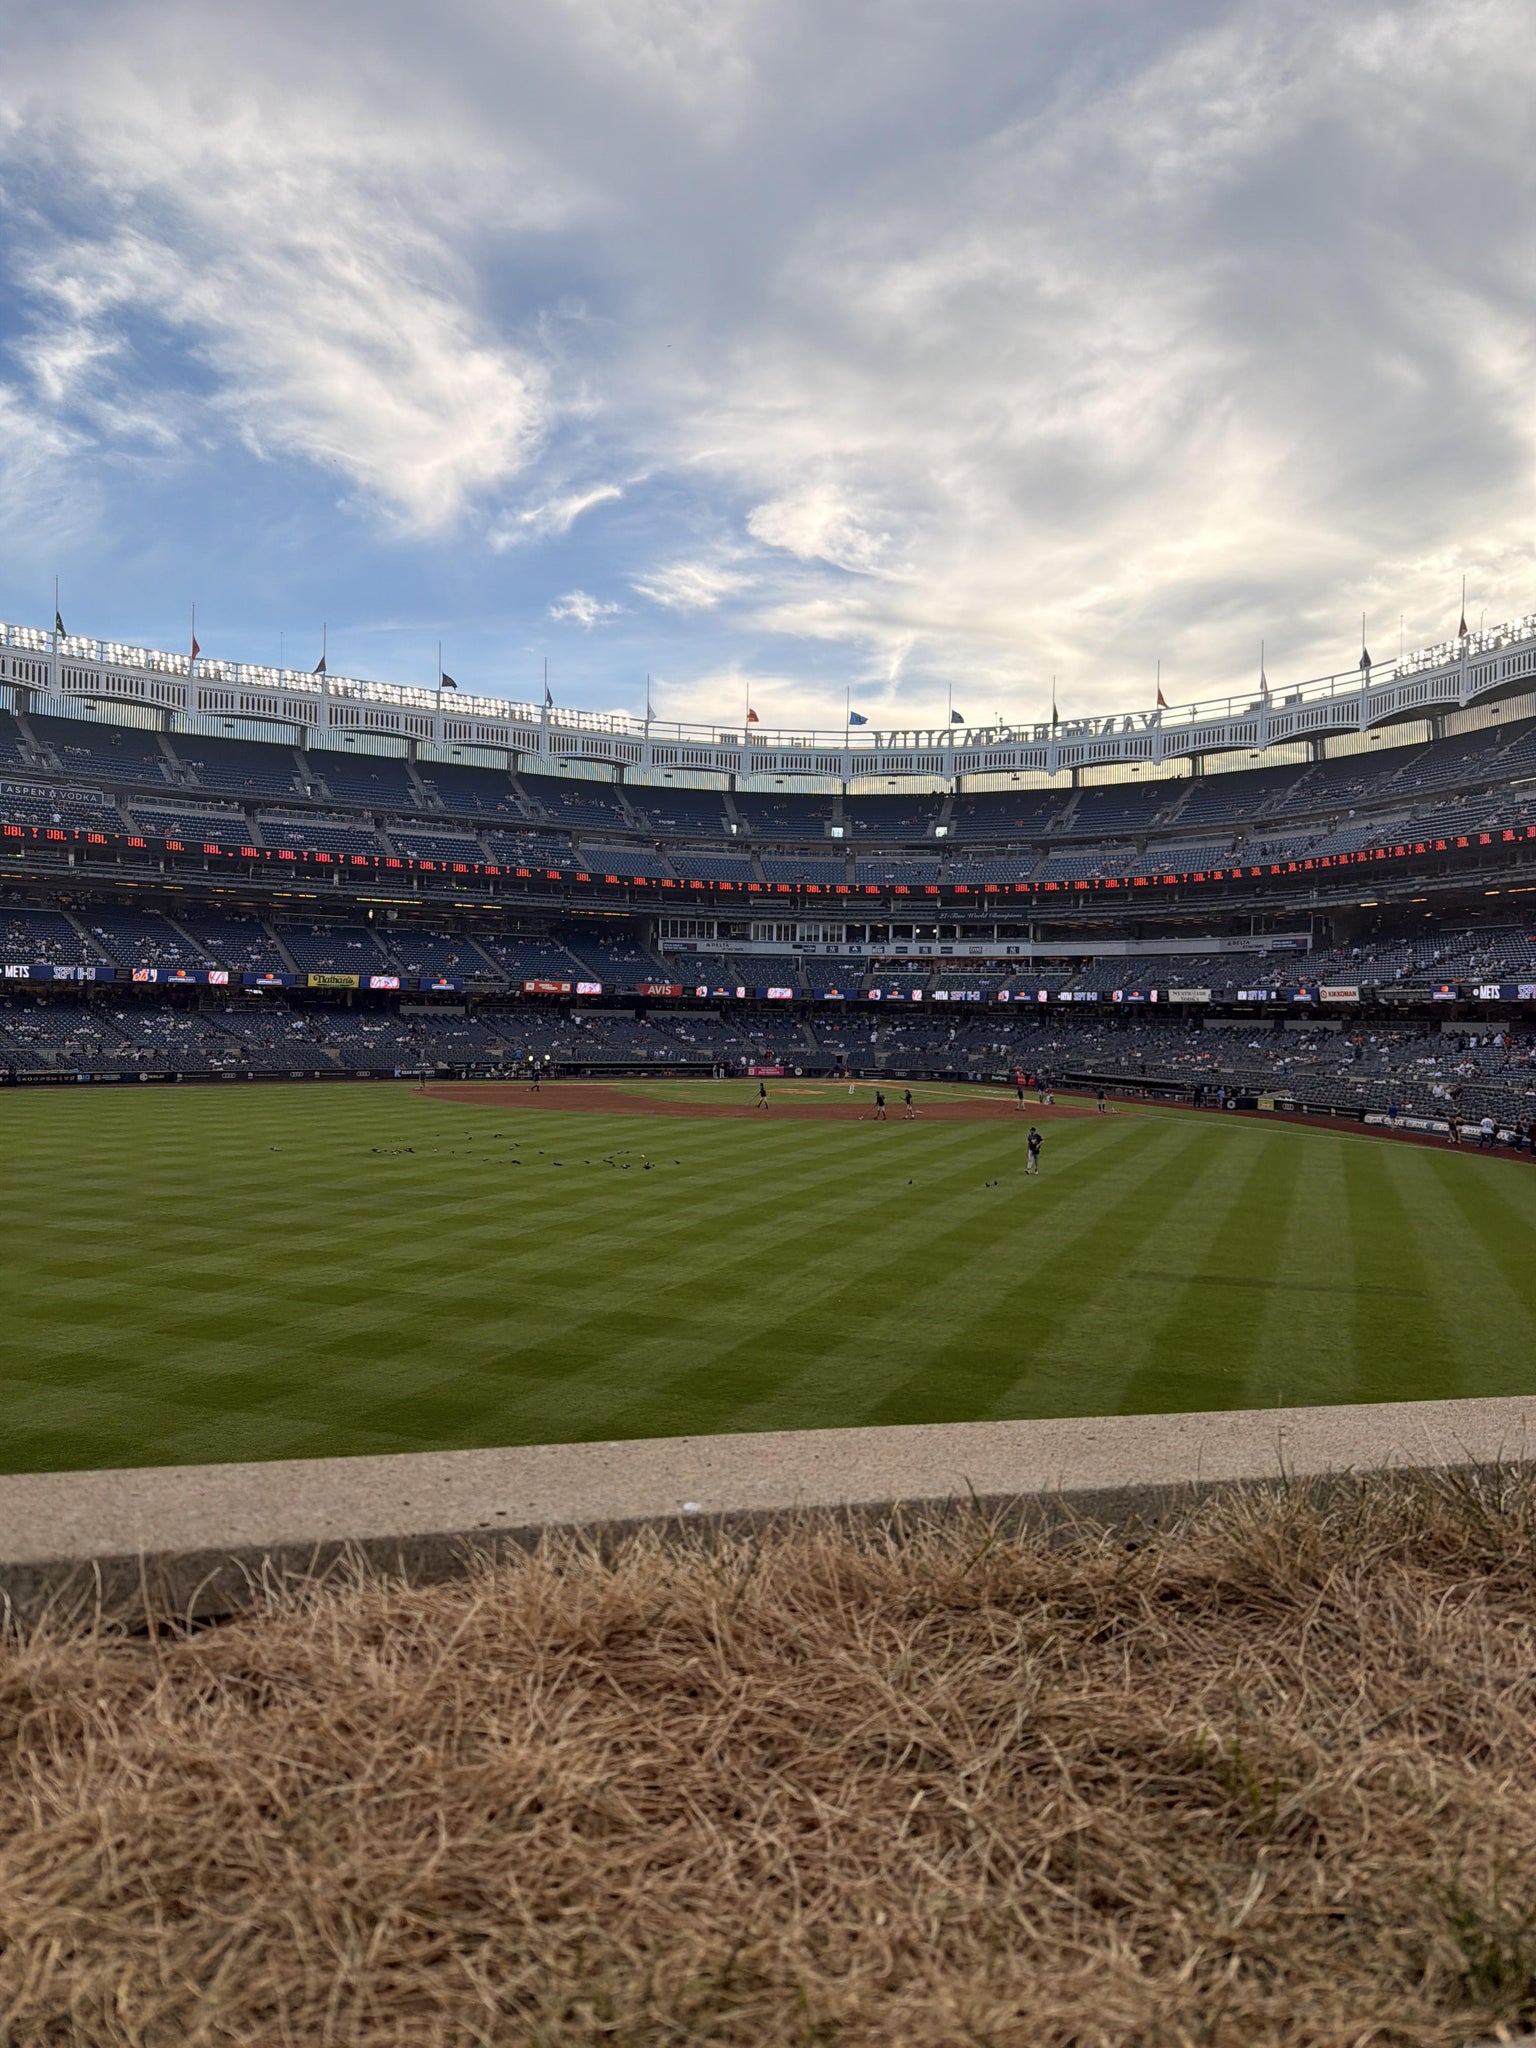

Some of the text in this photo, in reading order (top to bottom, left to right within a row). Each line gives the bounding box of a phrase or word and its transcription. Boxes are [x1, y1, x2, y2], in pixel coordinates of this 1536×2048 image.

[6, 785, 98, 802] ASPEN VODKA
[5, 965, 96, 981] METS SEPT 11-13
[313, 975, 354, 986] Nathan's
[648, 985, 672, 995] AVIS
[1480, 985, 1500, 999] METS
